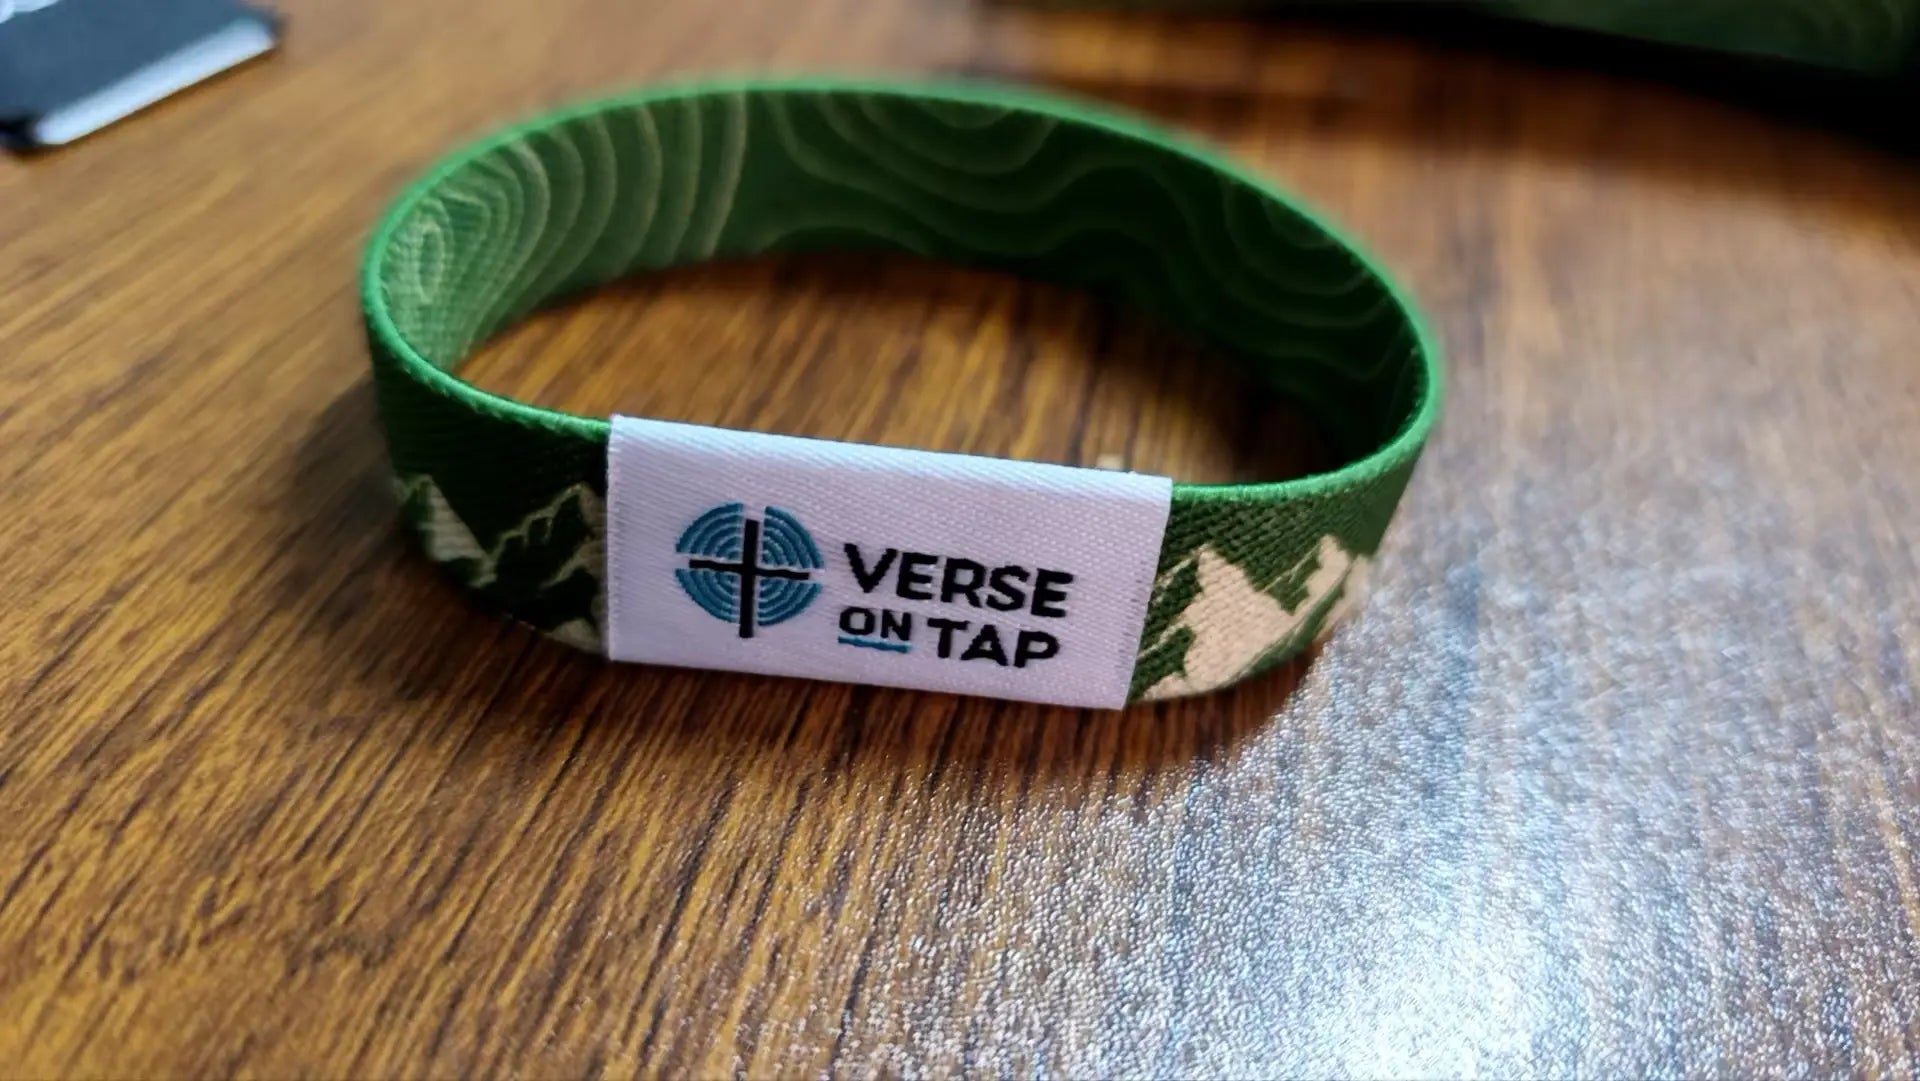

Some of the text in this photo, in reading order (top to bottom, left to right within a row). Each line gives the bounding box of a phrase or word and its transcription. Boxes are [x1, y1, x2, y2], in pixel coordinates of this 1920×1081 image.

[843, 542, 1075, 619] VERSE
[838, 605, 1061, 669] ON TAP
